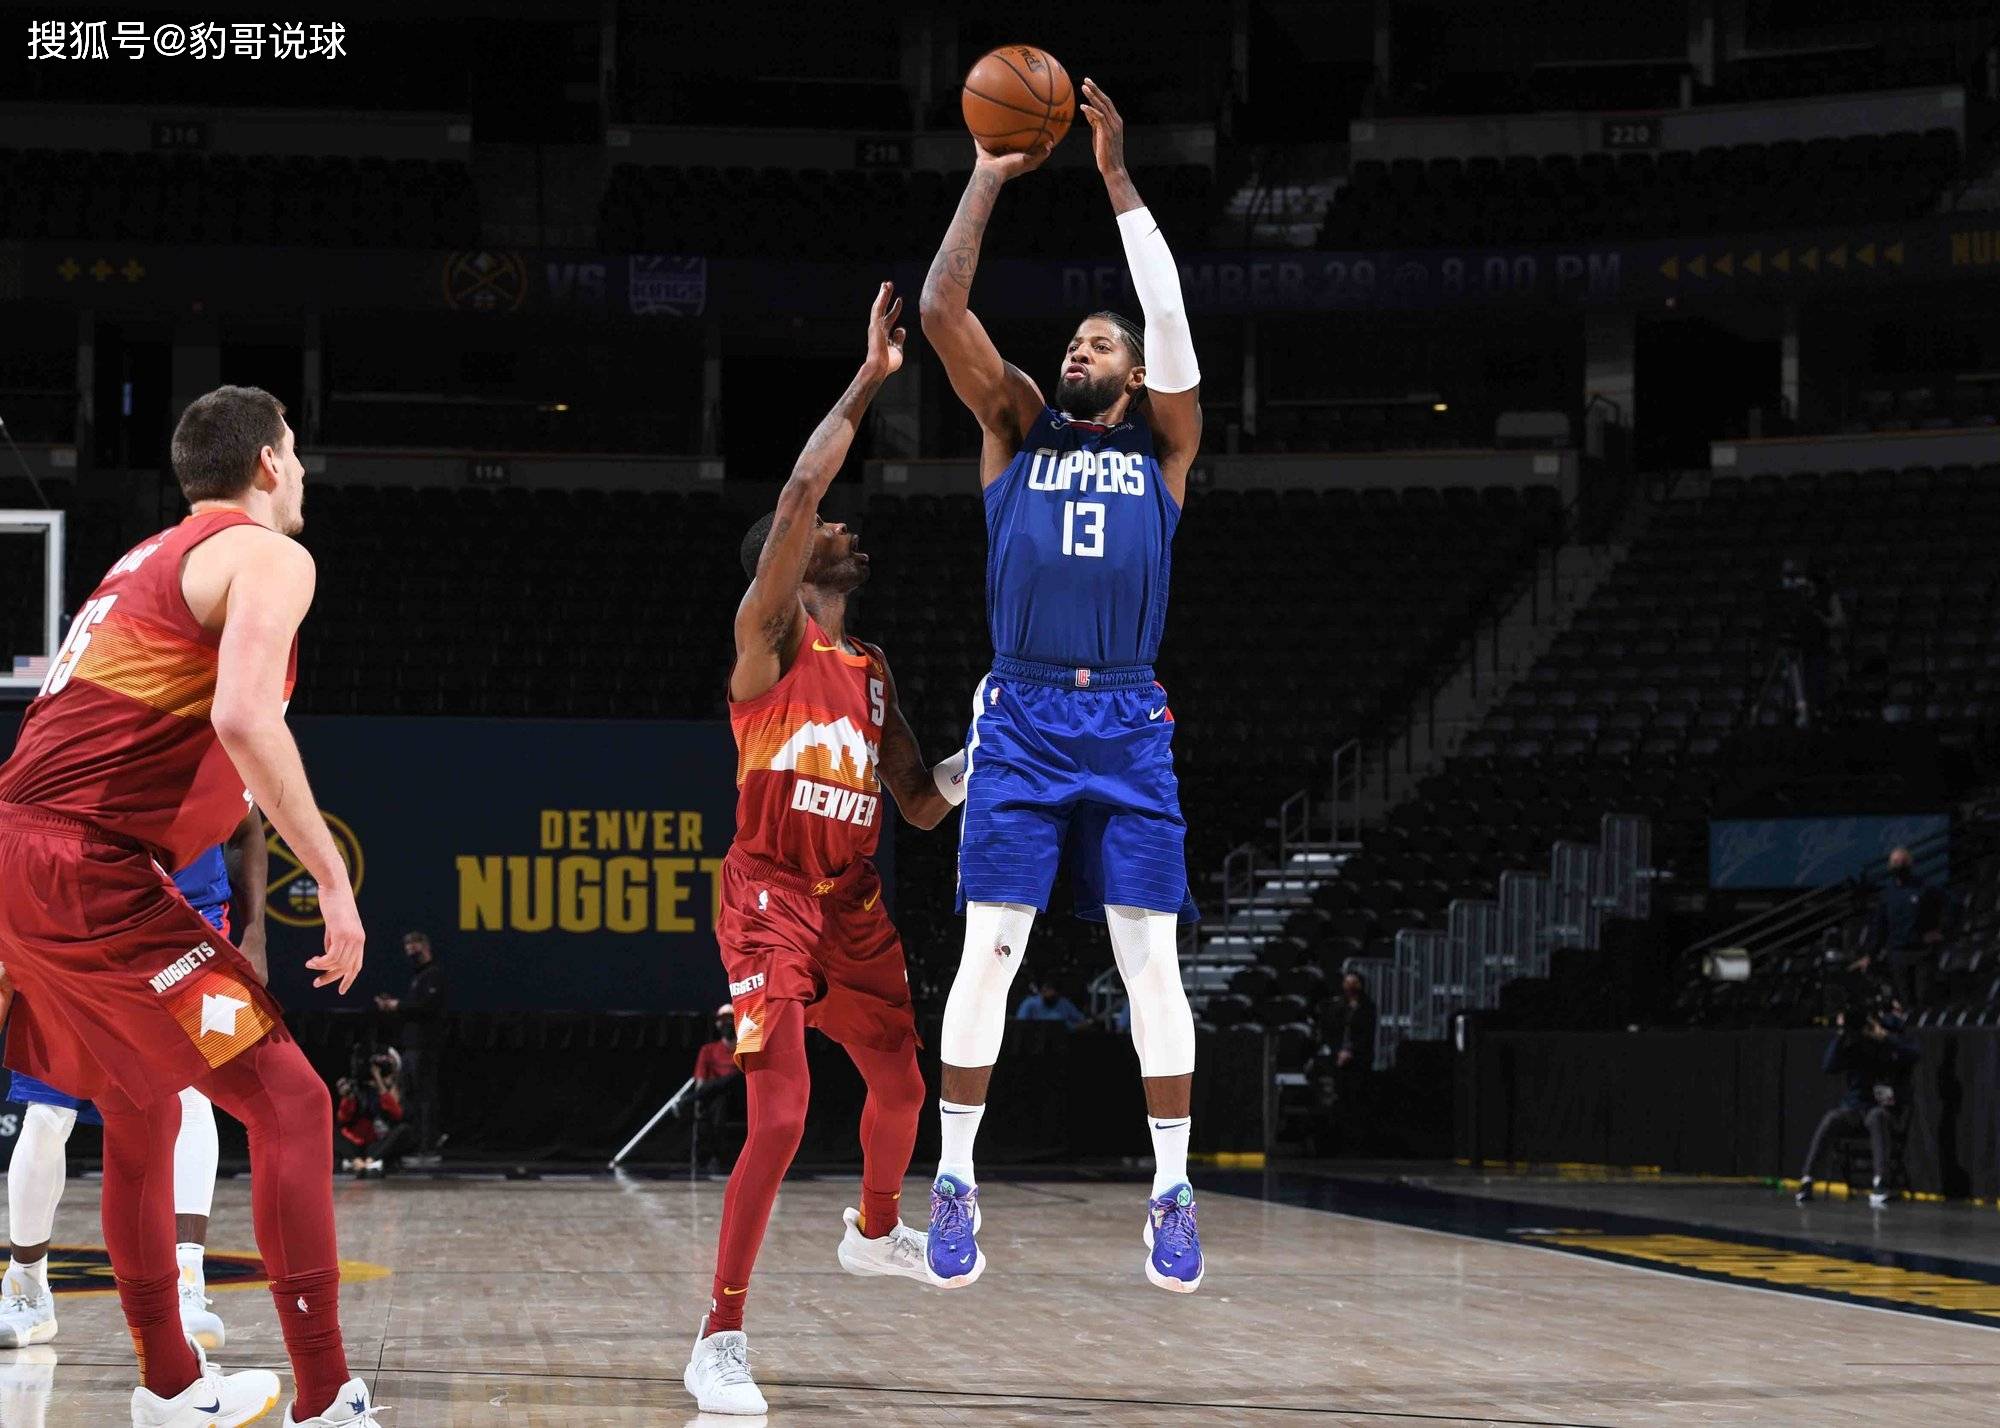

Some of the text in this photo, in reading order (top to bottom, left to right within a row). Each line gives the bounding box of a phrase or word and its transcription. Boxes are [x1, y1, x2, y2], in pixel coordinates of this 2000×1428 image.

[1609, 125, 1650, 144] 220
[1062, 263, 1305, 306] DEMBER
[1551, 252, 1621, 301] PM
[1028, 447, 1146, 497] CLIPPERS
[1062, 500, 1106, 558] 13
[790, 778, 878, 828] DENVER
[540, 809, 703, 850] DENVER
[148, 940, 217, 995] NUGGETS
